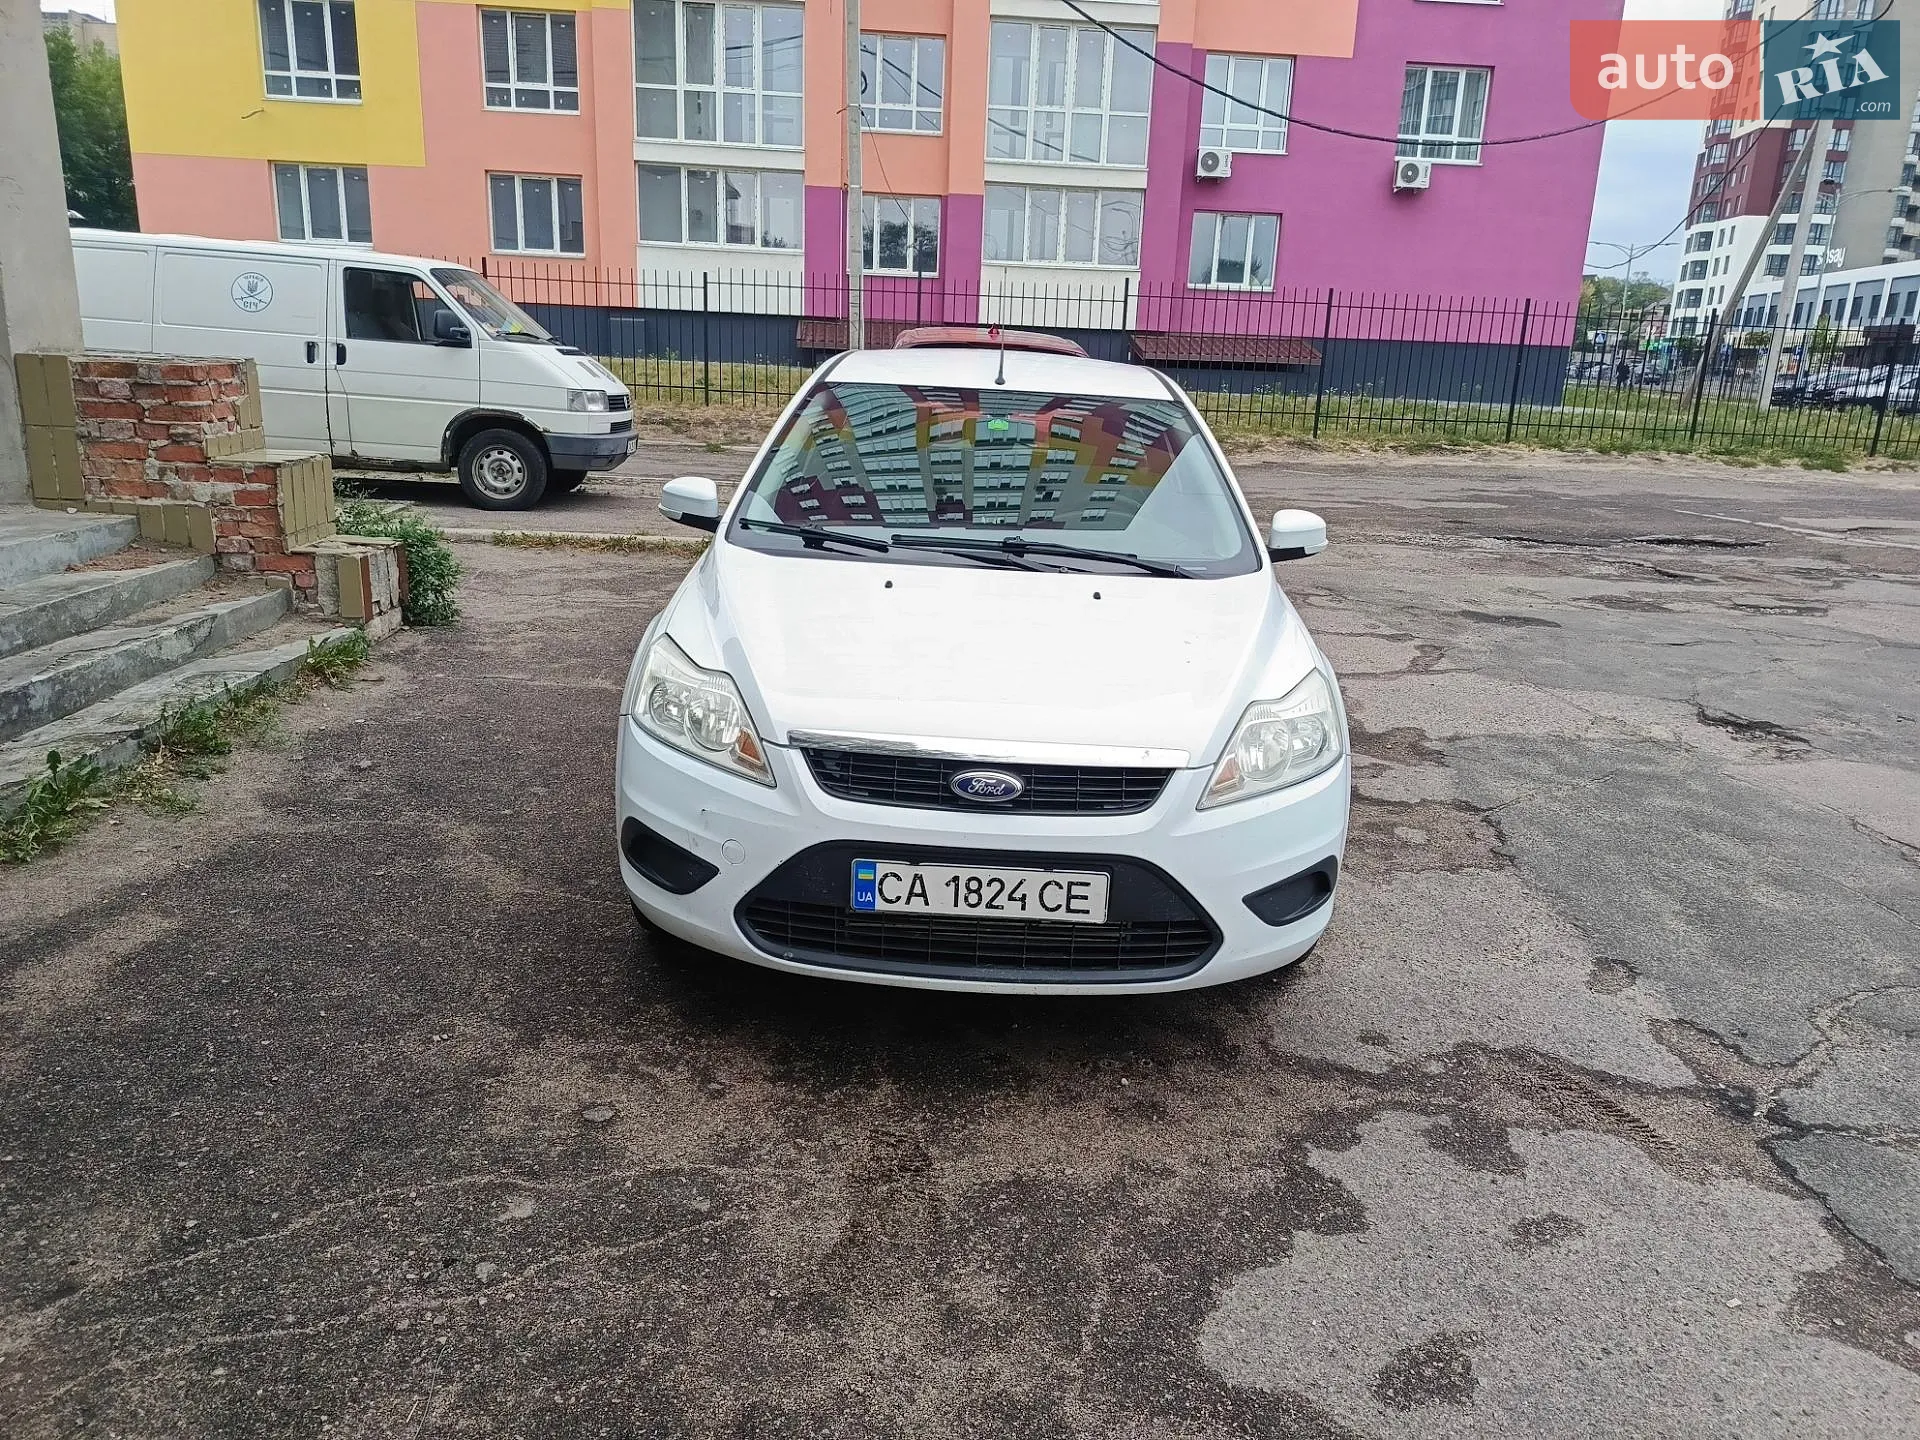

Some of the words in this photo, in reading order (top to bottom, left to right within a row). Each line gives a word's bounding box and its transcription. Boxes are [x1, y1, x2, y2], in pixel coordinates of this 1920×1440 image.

[1816, 247, 1846, 268] ssay
[967, 777, 1006, 796] Ford
[857, 891, 874, 903] UA
[877, 871, 930, 907] CA
[945, 875, 1027, 911] 1824
[1038, 880, 1092, 914] CE
